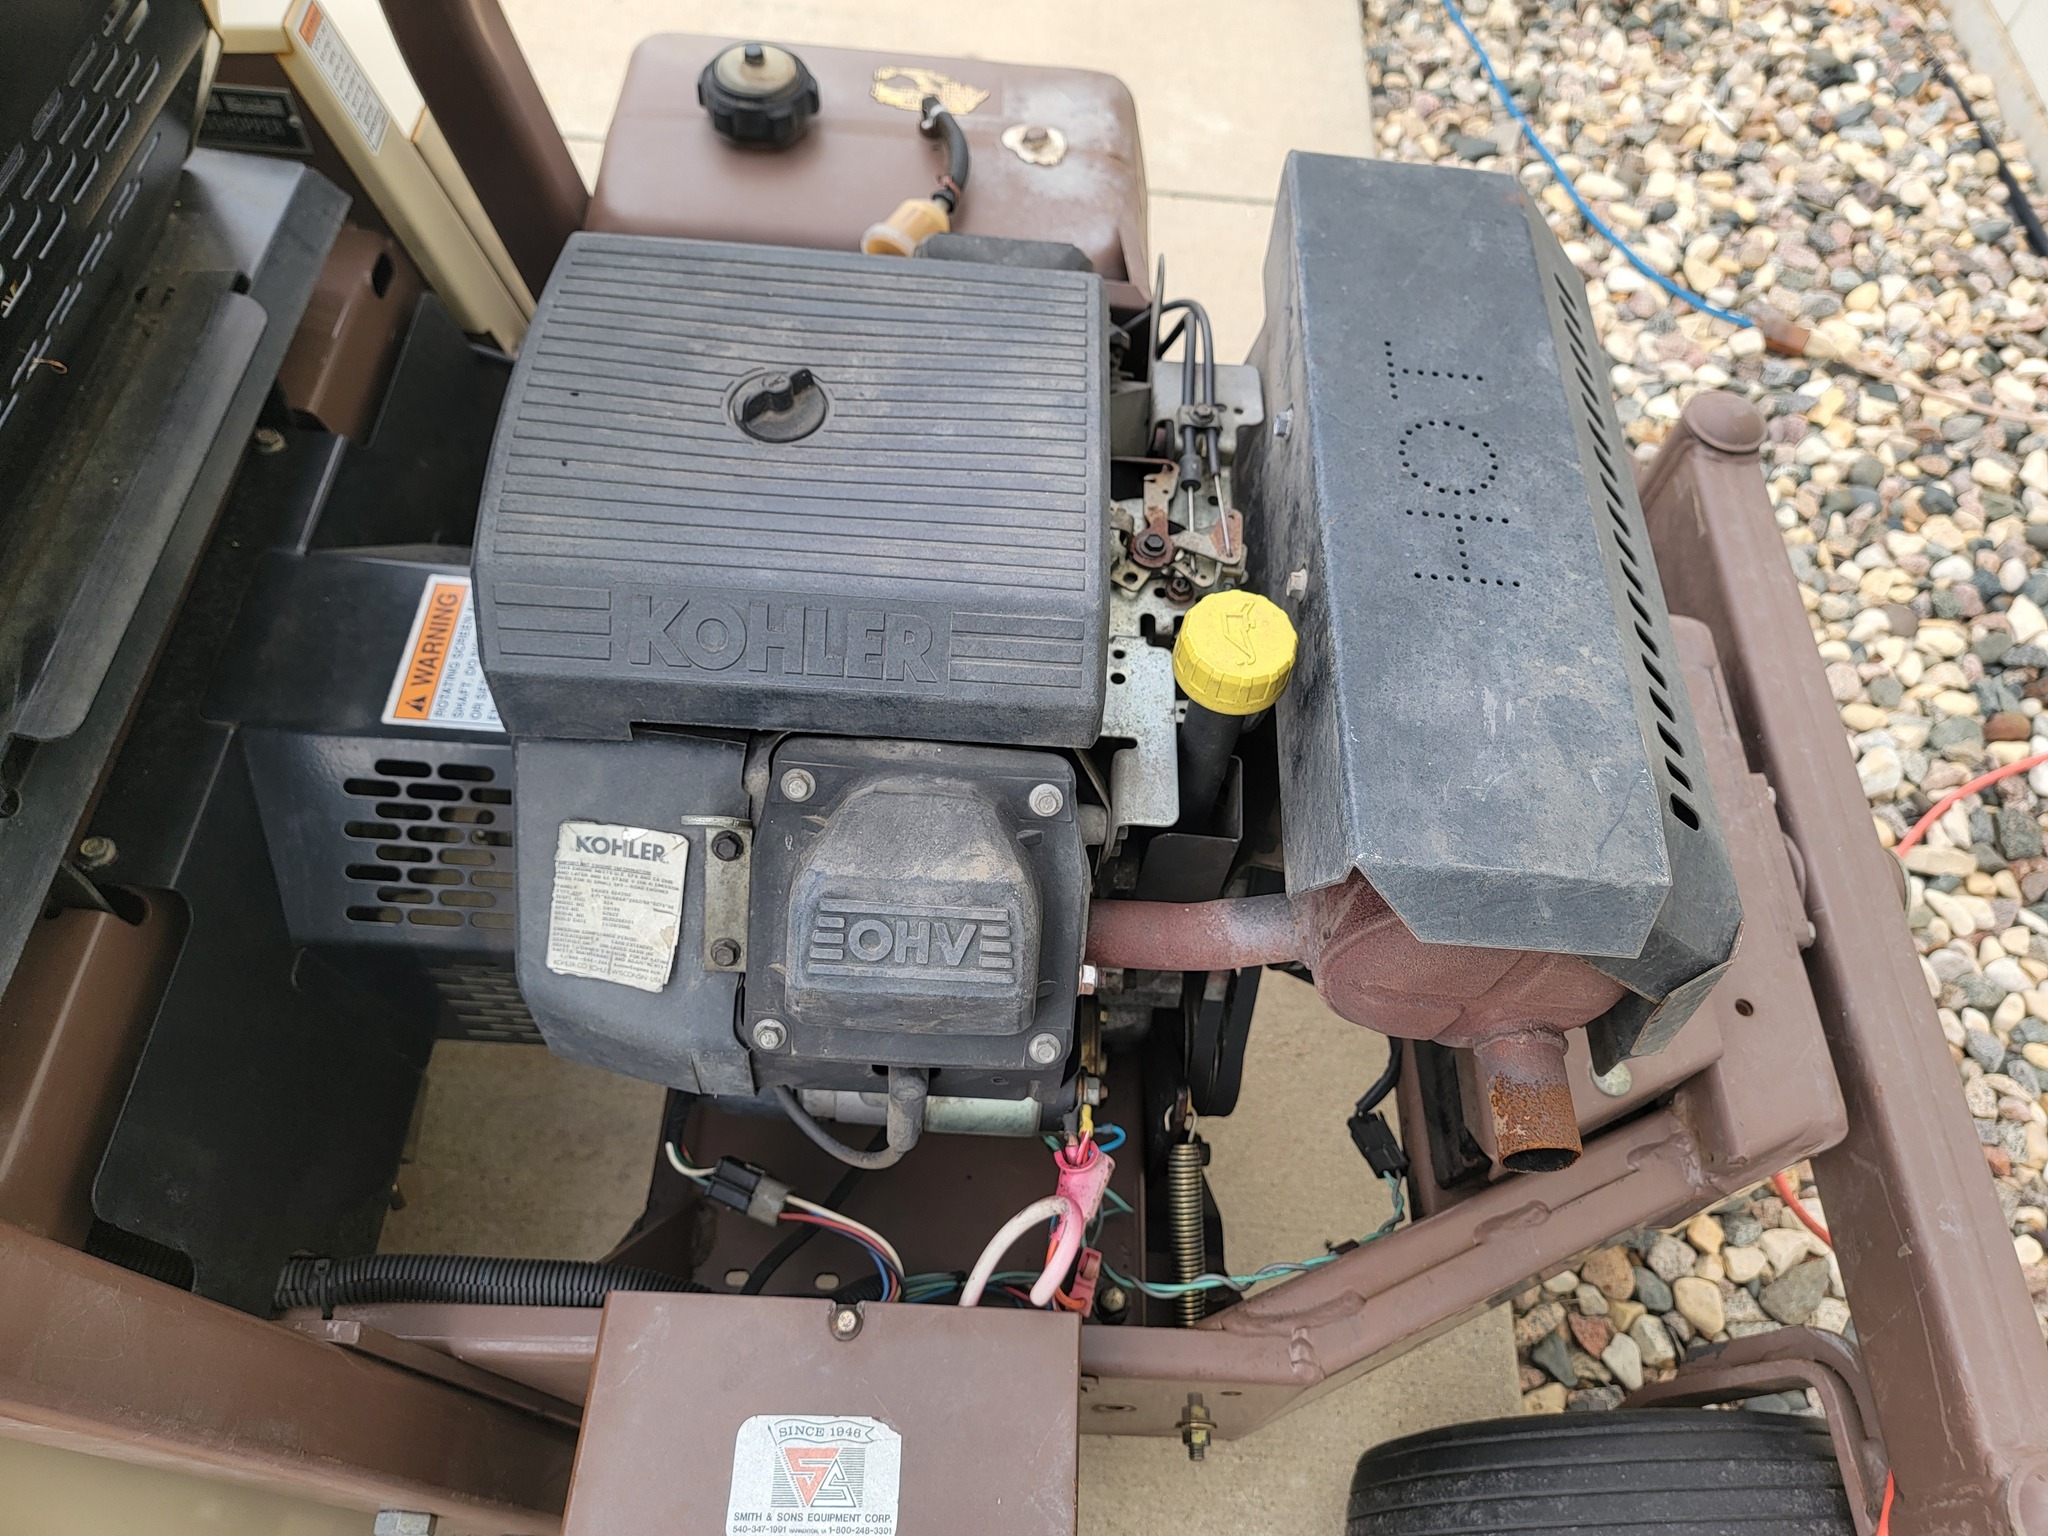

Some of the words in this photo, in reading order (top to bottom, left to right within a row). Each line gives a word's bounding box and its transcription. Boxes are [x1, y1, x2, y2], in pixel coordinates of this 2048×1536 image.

[1384, 341, 1521, 587] HOT
[411, 593, 459, 686] WARNING
[630, 594, 937, 683] KOHLER
[435, 662, 461, 718] ROTATING
[453, 614, 473, 660] SCREEN
[576, 836, 666, 862] KOHLER
[849, 919, 977, 966] OHV
[779, 1424, 825, 1437] SINCE
[830, 1426, 861, 1438] 1946
[732, 1525, 786, 1534] 540-347-1991
[829, 1526, 892, 1535] 1-800-248-3301
[734, 1512, 762, 1522] SMITH
[766, 1513, 772, 1522] &
[777, 1513, 803, 1522] SONS
[807, 1513, 861, 1523] EQUIPMENT
[864, 1514, 892, 1523] CORP.
